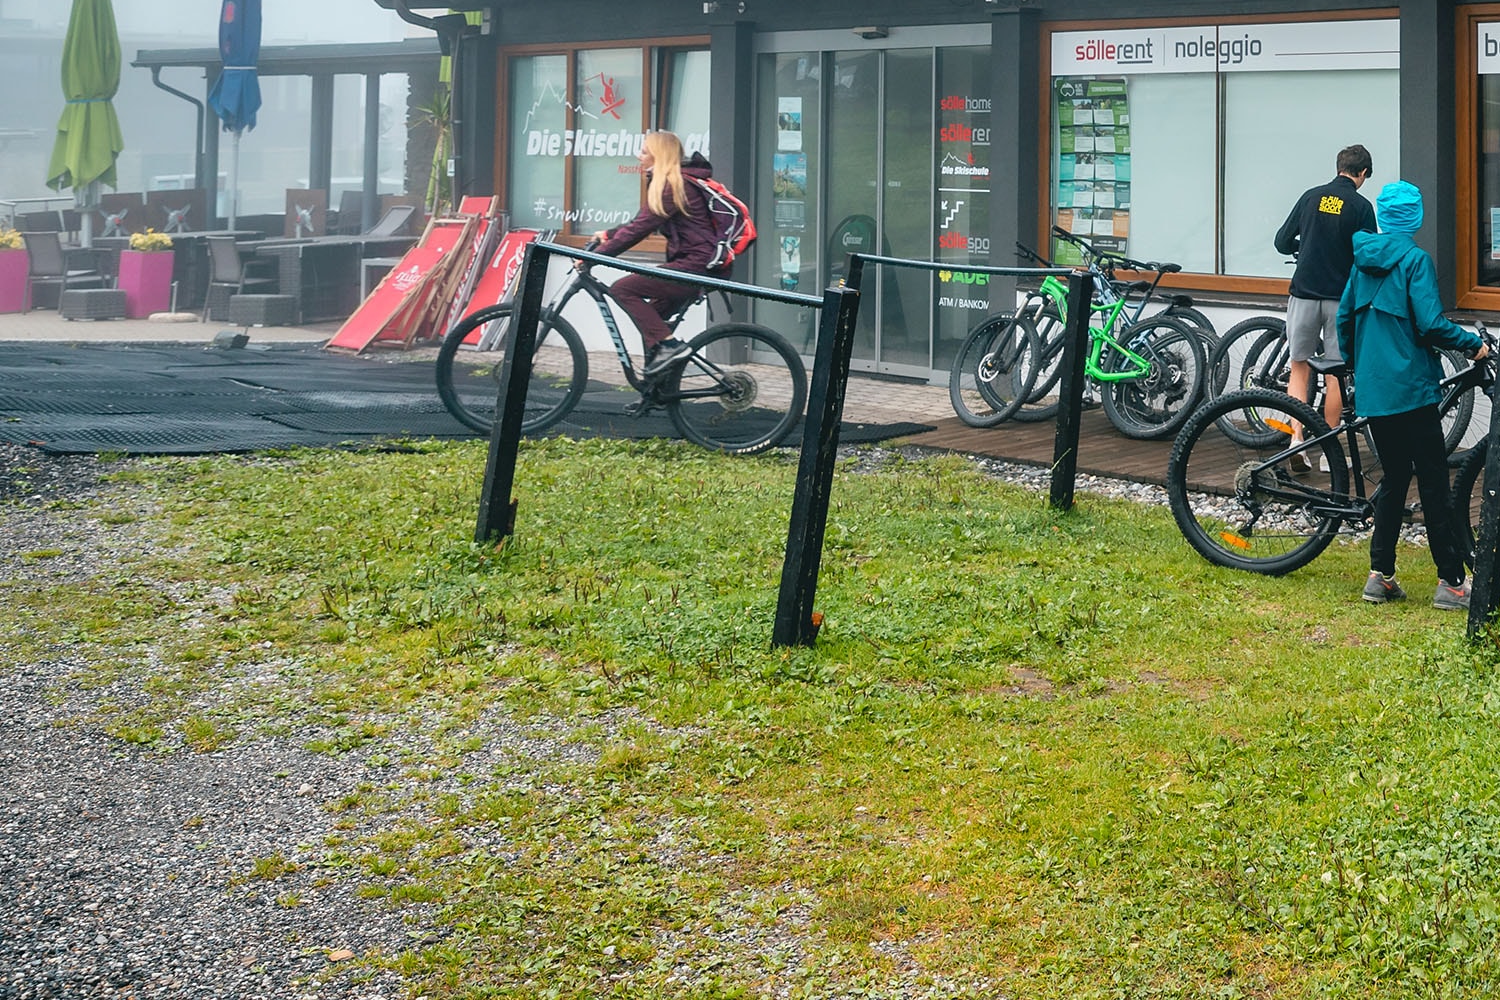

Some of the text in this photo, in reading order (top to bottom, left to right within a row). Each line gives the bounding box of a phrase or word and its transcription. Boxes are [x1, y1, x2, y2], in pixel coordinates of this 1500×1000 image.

[1075, 33, 1262, 64] söllerent noleggio
[526, 128, 562, 156] Die
[952, 267, 990, 286] ADE
[938, 296, 954, 307] ATM
